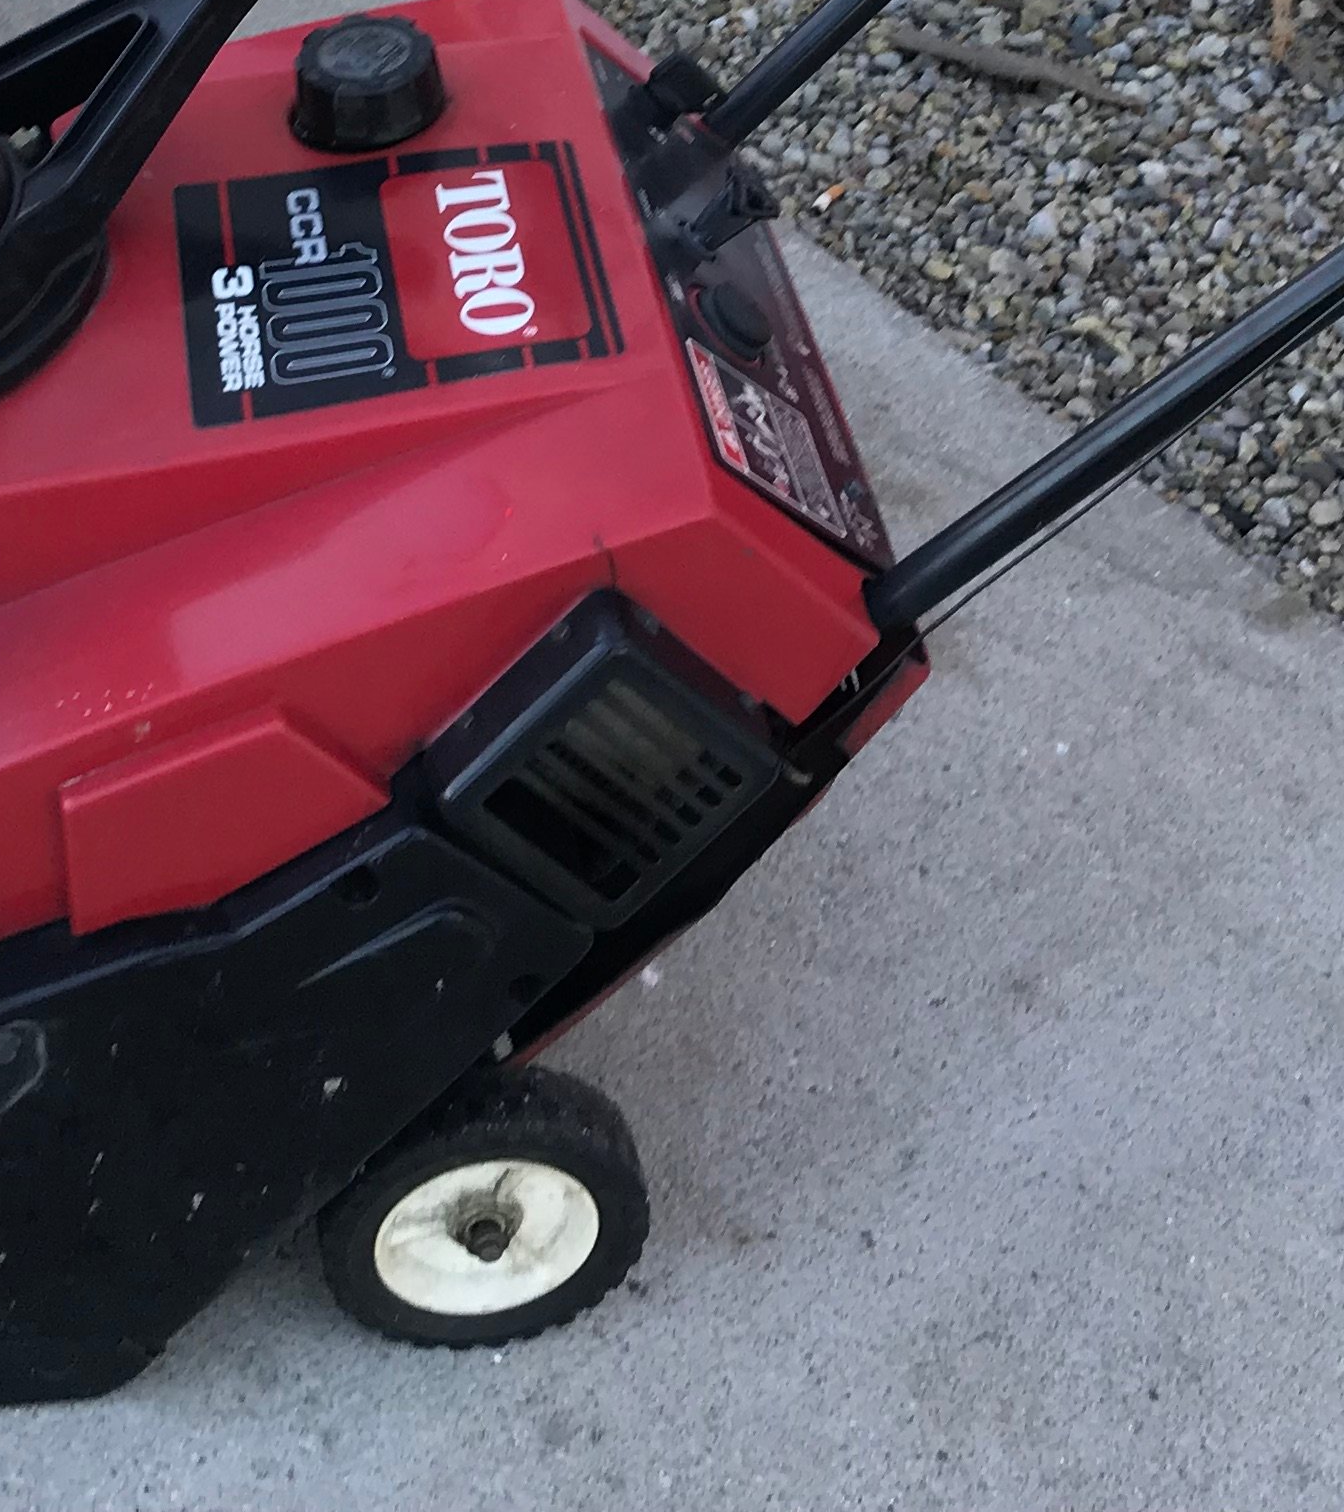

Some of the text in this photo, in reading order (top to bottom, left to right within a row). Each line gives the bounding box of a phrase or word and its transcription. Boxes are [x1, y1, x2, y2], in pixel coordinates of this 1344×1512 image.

[259, 187, 395, 385] CCR 1000
[435, 169, 535, 336] TORO
[211, 265, 266, 389] 3 HORSE
[214, 301, 243, 393] POWER
